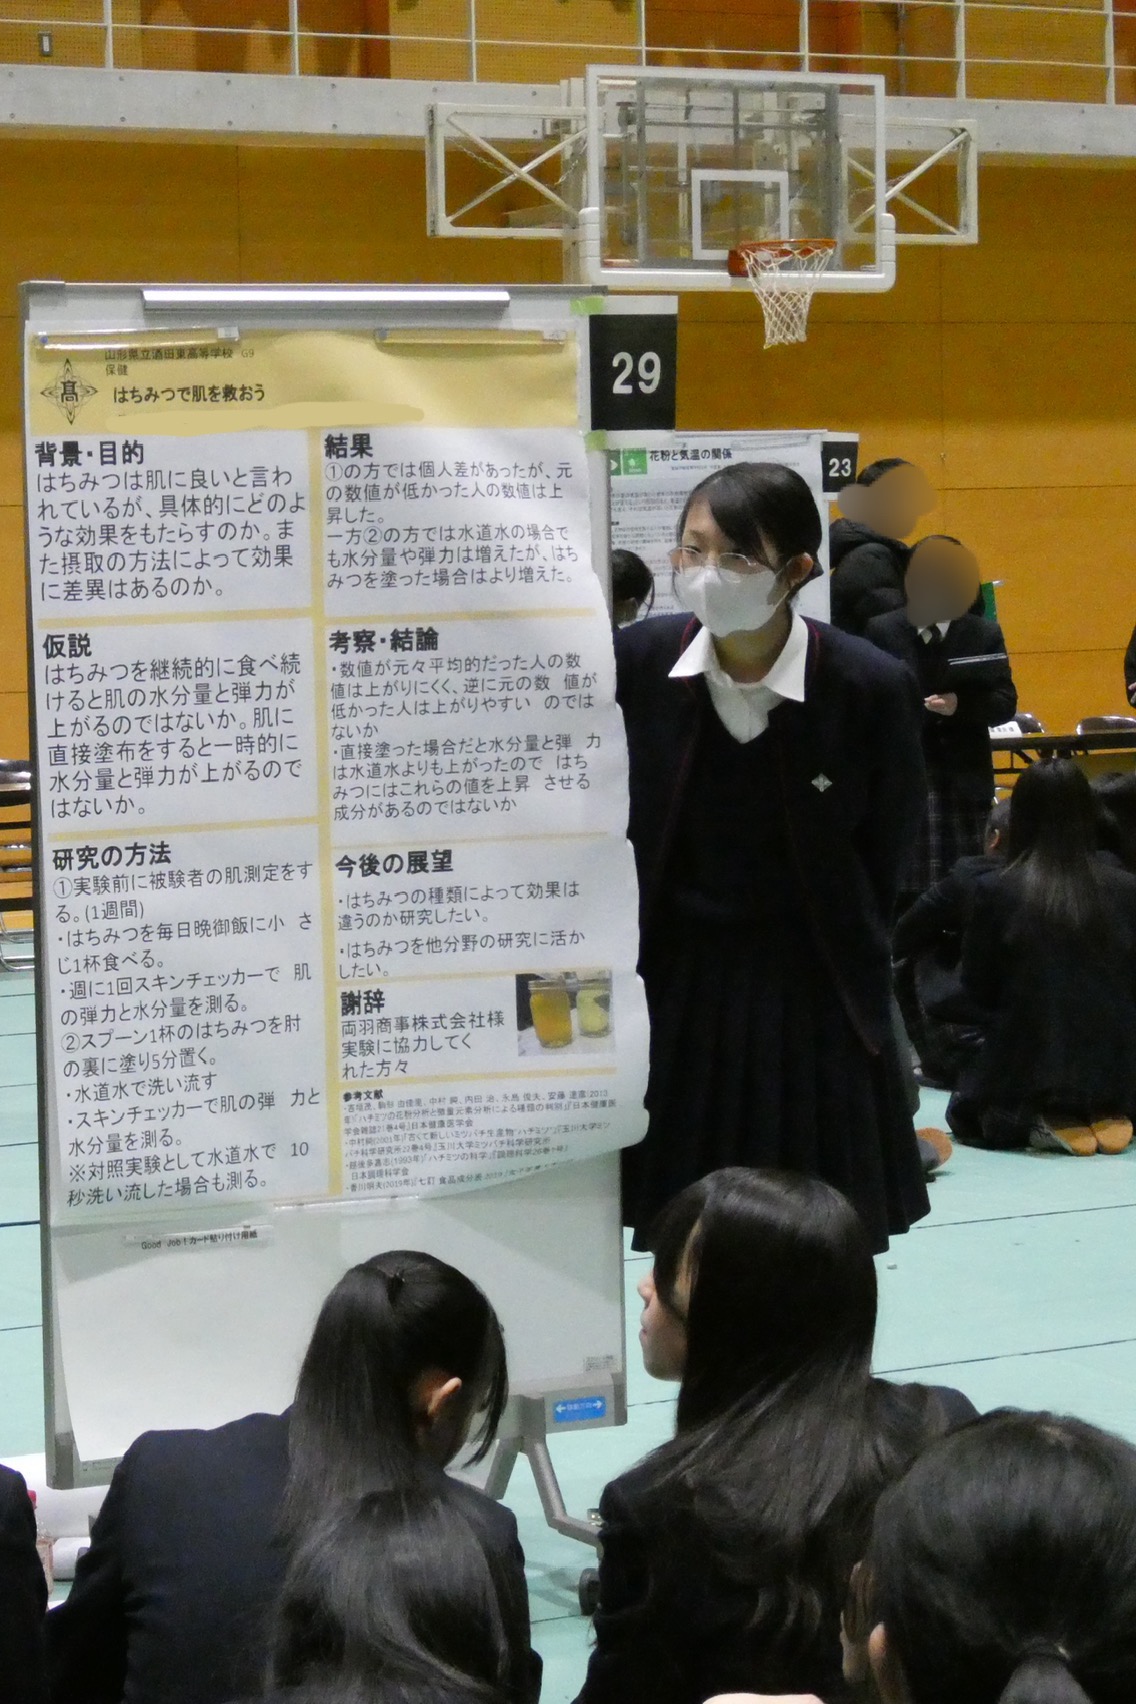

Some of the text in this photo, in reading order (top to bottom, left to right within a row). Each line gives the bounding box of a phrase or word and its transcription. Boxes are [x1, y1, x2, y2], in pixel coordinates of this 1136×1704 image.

[105, 364, 128, 376] 保健
[612, 351, 661, 394] 29
[113, 383, 265, 403] はちみつで肌を救おう
[35, 440, 144, 467] 背景・目的
[324, 433, 373, 459] 結果
[649, 447, 733, 462] 花粉と気温の関係
[37, 466, 292, 492] はちみつは肌に良いと言わ
[325, 461, 573, 482] ①の方では個人差があったが、元
[829, 458, 852, 477] 23
[326, 482, 564, 502] の数値が低かった人の数値は上
[37, 492, 306, 520] れているが、具体的にどのよ
[326, 506, 385, 524] 昇した。
[38, 518, 295, 547] うな効果をもたらすのか。ま
[327, 523, 569, 545] 一方②の方では水道水の場合で
[39, 545, 294, 575] た摂取の方法によって効果
[327, 545, 579, 568] も水分量や弾力は増えたが、はち
[41, 576, 223, 601] に差異はあるのか。
[327, 566, 574, 589] みつを塗った場合はより増えた。
[43, 633, 92, 659] 仮説
[329, 626, 439, 654] 考察・結論
[45, 652, 301, 685] はちみつを継続的に食べ続
[46, 678, 295, 712] けると肌の水分量と弾力が
[47, 707, 294, 739] 上がるのではないか。肌に
[331, 722, 379, 740] ないか
[48, 733, 299, 766] 直接塗布をすると一時的に
[49, 759, 302, 793] 水分量と弾力が上がるので
[51, 795, 146, 819] はないか。
[334, 797, 517, 821] 成分があるのではないか
[52, 841, 172, 871] 研究の方法
[335, 849, 454, 879] 今後の展望
[53, 861, 313, 899] ①実験前に被験者の肌測定をす
[338, 881, 580, 909] ・はちみつの種類によって効果は
[337, 908, 489, 931] 違うのか研究したい。
[340, 929, 585, 959] ・はちみつを他分野の研究に活か
[58, 949, 164, 975] じ1杯食べる。
[339, 962, 390, 980] したい。
[61, 993, 247, 1026] の弾力と水分量を測る。
[340, 988, 385, 1016] 謝辞
[341, 1010, 505, 1037] 両羽商事株式会社様
[341, 1032, 472, 1059] 実験に協力してく
[64, 1046, 217, 1078] の裏に塗り5分置く。
[342, 1059, 408, 1080] れた方々
[67, 1071, 217, 1103] ・水道水で洗い流す
[69, 1128, 182, 1157] 水分量を測る。
[67, 1169, 268, 1208] 秒洗い流した場合も測る。
[142, 1241, 162, 1250] Good
